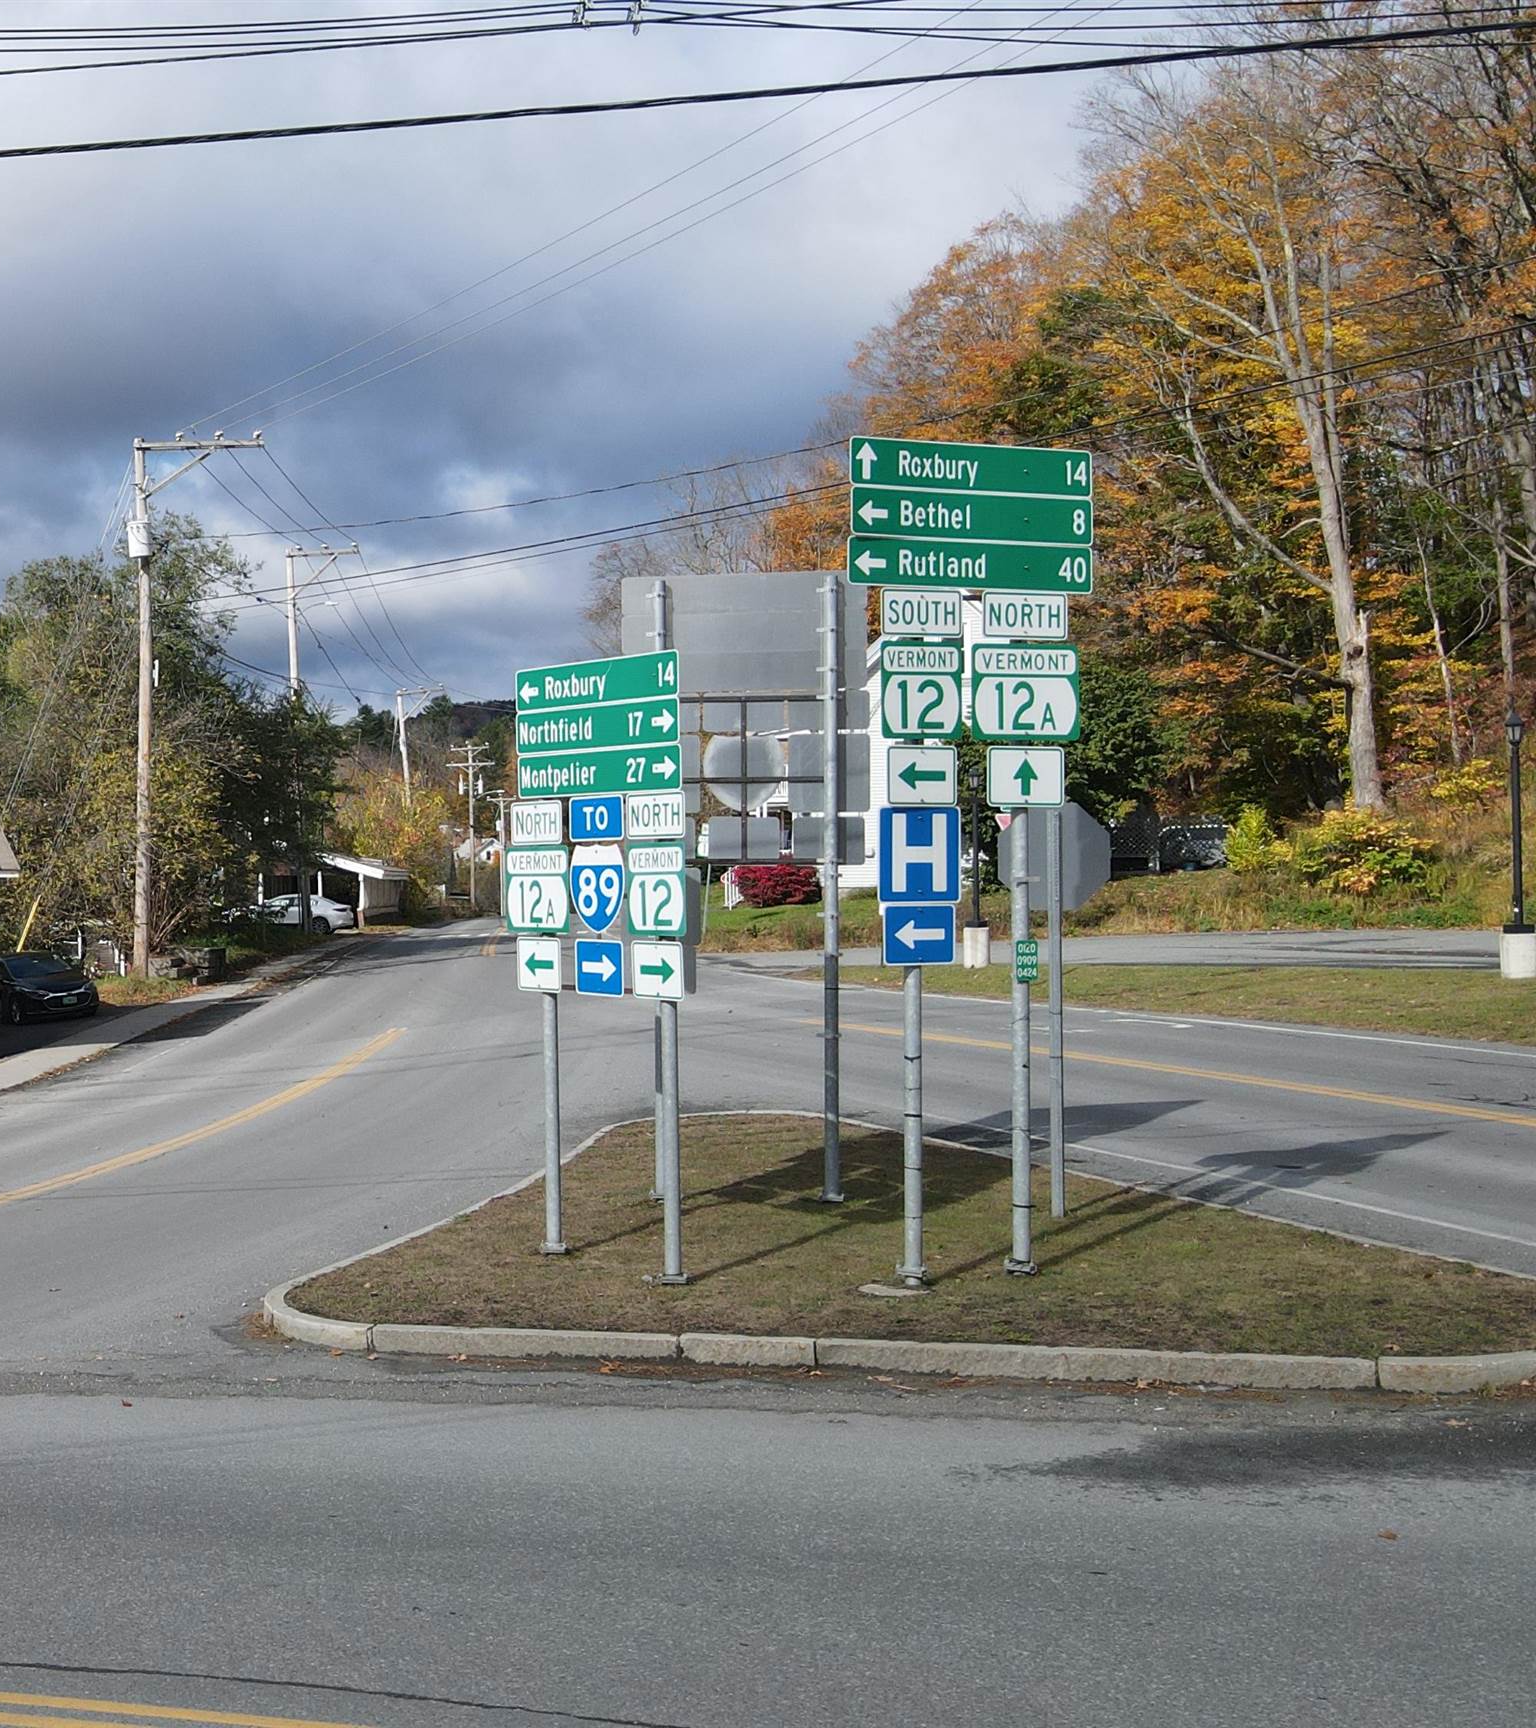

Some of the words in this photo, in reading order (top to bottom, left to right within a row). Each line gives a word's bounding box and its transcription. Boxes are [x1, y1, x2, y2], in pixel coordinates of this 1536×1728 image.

[898, 450, 979, 488] Roxbury
[1065, 460, 1087, 487] 14
[900, 500, 971, 530] Bethel
[1072, 509, 1086, 535] 8
[898, 549, 987, 579] Rutland
[1058, 557, 1087, 583] 40
[888, 599, 956, 626] SOUTH
[989, 603, 1061, 628] NORTH
[887, 650, 955, 668] VERMONT
[982, 653, 1069, 671] VERMONT
[544, 672, 607, 700] Roxbury
[657, 660, 675, 688] 14
[897, 679, 945, 730] 12
[994, 681, 1056, 731] 12A
[519, 715, 593, 745] Northfield
[627, 711, 644, 737] 17
[521, 761, 597, 793] Montpelier
[626, 757, 646, 783] 27
[515, 810, 558, 836] NORTH
[582, 805, 609, 832] TO
[630, 802, 681, 828] NORTH
[511, 854, 562, 871] VERMONT
[631, 851, 680, 868] VERMONT
[891, 812, 947, 893] H
[519, 879, 556, 925] 12A
[578, 867, 620, 918] 89
[638, 878, 673, 927] 12
